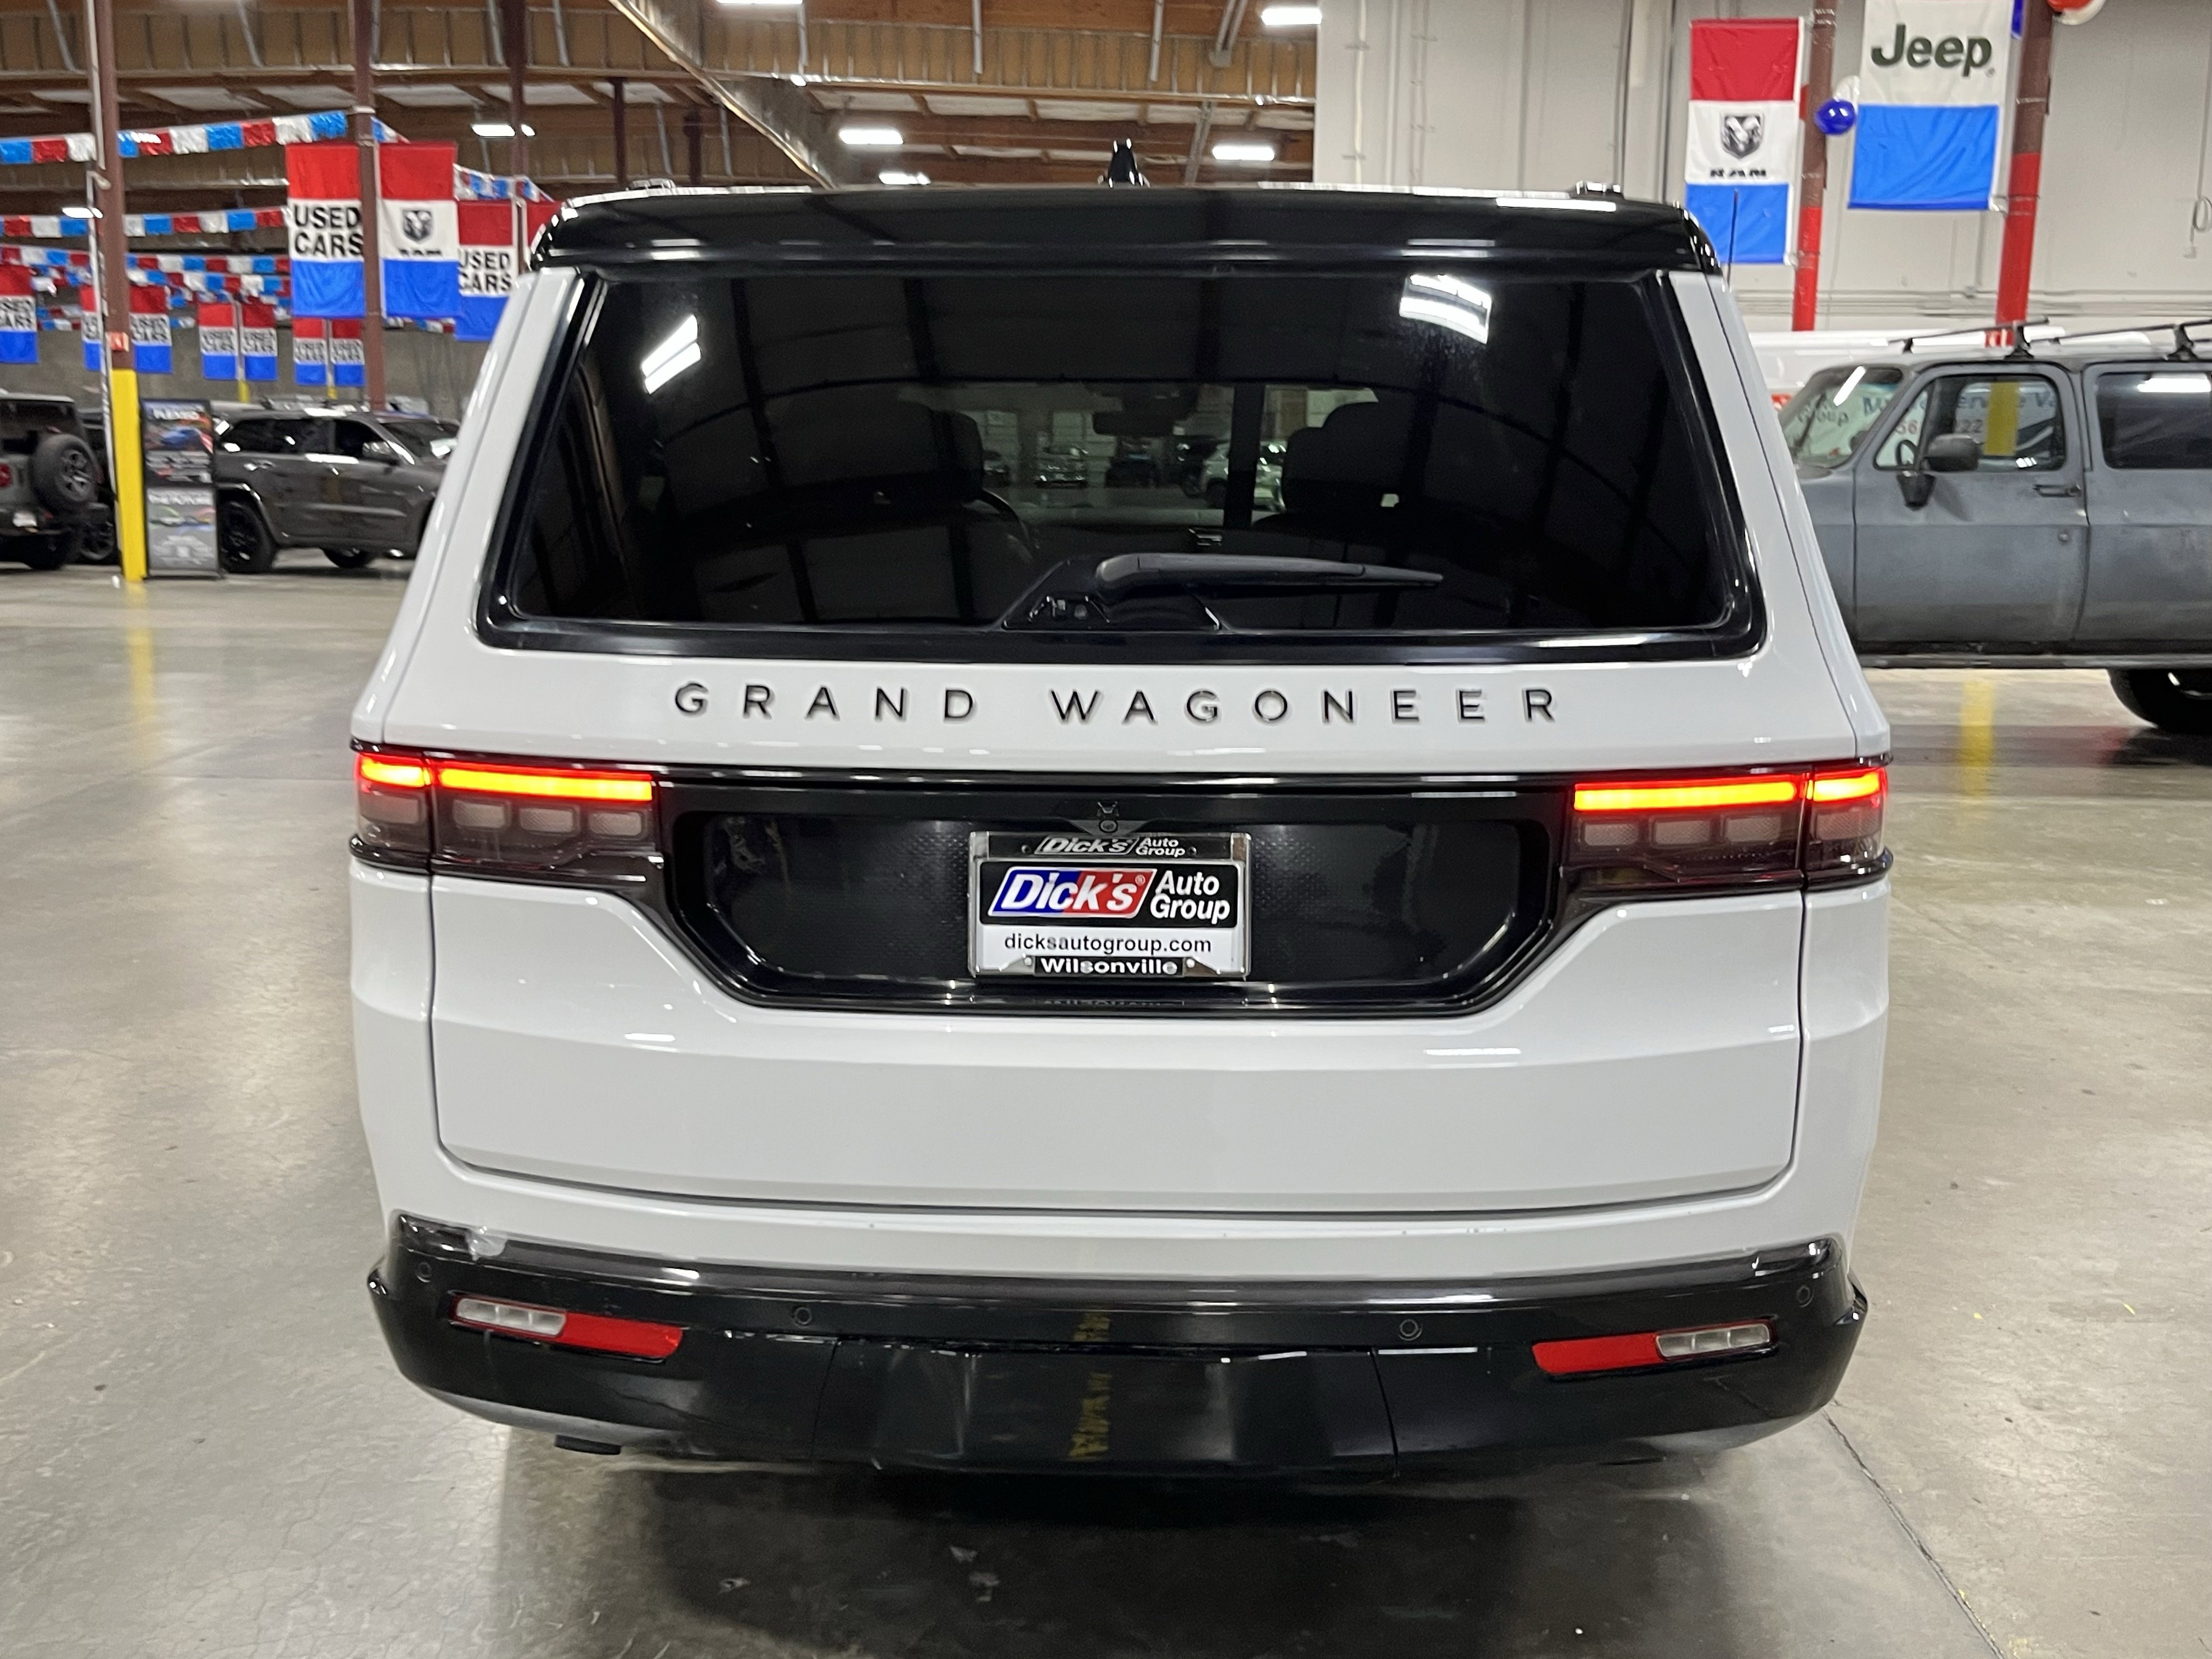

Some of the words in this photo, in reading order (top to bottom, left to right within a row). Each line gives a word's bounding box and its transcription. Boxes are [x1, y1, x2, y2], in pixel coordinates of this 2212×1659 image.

[1871, 23, 1992, 76] Jeep
[294, 204, 362, 228] USED
[295, 232, 364, 257] CARS
[674, 682, 975, 721] GRAND
[1049, 688, 1555, 725] WAGONEER
[1043, 837, 1134, 854] Dick's
[1136, 847, 1186, 857] Group
[1139, 837, 1179, 848] Auto
[1001, 872, 1137, 911] Dick's
[1155, 870, 1220, 896] Auto
[1150, 896, 1231, 924] Group
[1005, 933, 1212, 956] dicksautogroup.com
[1041, 958, 1178, 975] Wilsonville
